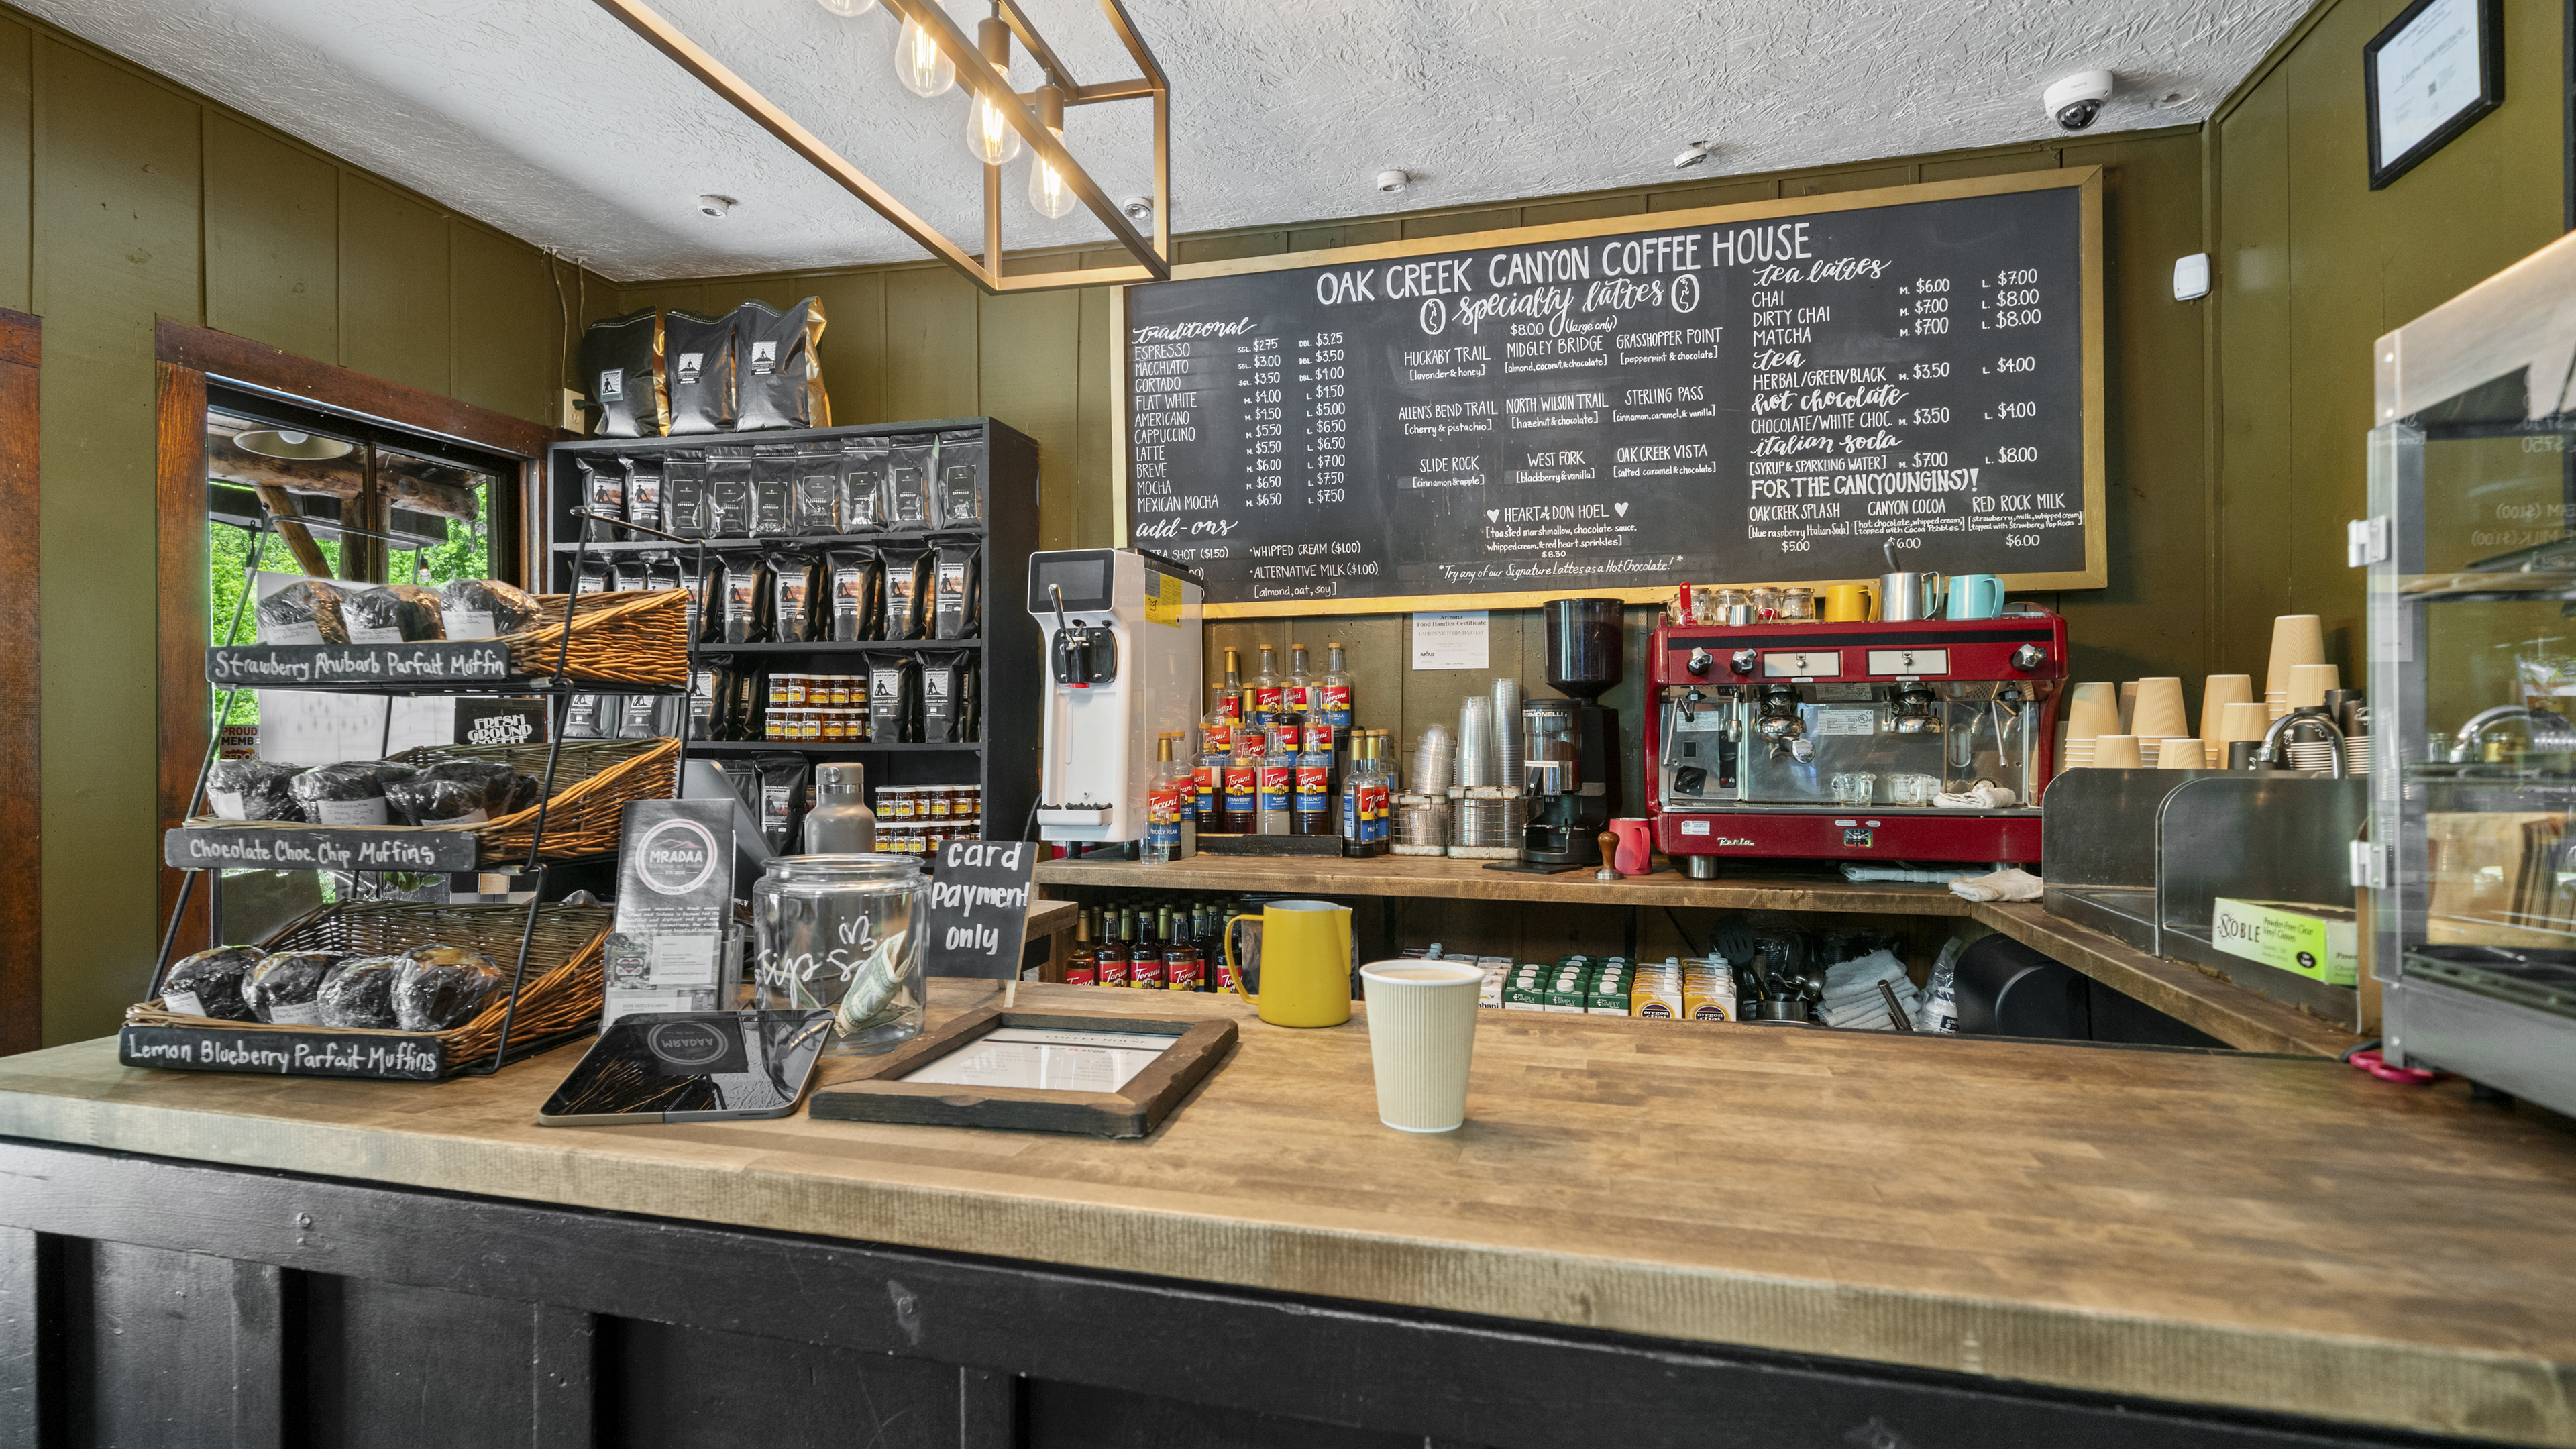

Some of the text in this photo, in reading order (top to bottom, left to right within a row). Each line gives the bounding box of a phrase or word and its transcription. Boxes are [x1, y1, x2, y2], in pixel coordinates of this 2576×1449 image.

[1317, 222, 1812, 305] OAK CREEK CANYON COFFEE HOUSE
[1753, 258, 1891, 286] tea lattes
[1752, 269, 2037, 307] CHAI $6.00 $7.00
[1452, 278, 1664, 337] specialty lattes
[1754, 306, 1829, 327] DIRTY CHAI
[1132, 317, 1257, 344] traditional
[1511, 315, 1617, 336] $8.00 (large only)
[1135, 332, 1343, 361] ESPRESSO $2.75 $3.25
[1507, 335, 1603, 358] MIDGLEY BRIDGE
[1617, 327, 1723, 349] GRASSHOPPER POINT
[1754, 327, 1811, 347] MATCHA
[1405, 346, 1491, 366] HUCKABY TRAIL
[1753, 349, 1806, 370] tea
[1136, 360, 1188, 376] MACCHIATO
[1410, 364, 1485, 380] [lavender & honey]
[1136, 377, 1181, 392] CORTADO
[1752, 366, 1886, 390] HERBAL/GREEN/BLACK
[1136, 392, 1197, 411] FLAT WHITE
[1507, 393, 1609, 413] NORTH WILSON TRAIL
[1625, 386, 1703, 405] STERLING PASS
[1752, 384, 1909, 415] hot chocolate
[1135, 411, 1189, 427] AMERICANO
[1399, 401, 1498, 420] ALLEN'S BEND TRAIL
[1752, 411, 1892, 434] CHOCOLATE/WHITE CHOC.
[1135, 427, 1195, 444] CAPPUCCINO
[1750, 430, 1902, 457] italian soda
[1136, 445, 1164, 461] LATTE
[1527, 451, 1585, 466] WEST FORK
[1617, 444, 1707, 462] OAK CREEK VISTA
[1137, 463, 1167, 478] BREVE
[1420, 456, 1479, 472] SLIDE ROCK
[1138, 480, 1171, 495] MOCHA
[1751, 468, 1979, 500] FOR THE CAN(YOUNGINS)!
[1138, 494, 1218, 512] MEXICAN MOCHA
[1750, 503, 1839, 521] OAK CREEK SPLASH
[1868, 498, 1945, 515] CANYON COCOA
[1972, 493, 2065, 513] RED ROCK MILK
[1505, 506, 1541, 522] HEART
[1553, 506, 1574, 519] DON
[1579, 504, 1609, 518] HOEL
[1136, 517, 1238, 538] add-ons
[1172, 546, 1228, 560] SHOT ($1.50)
[1253, 541, 1360, 557] WHIPPED CREAM ($1.00)
[1254, 561, 1378, 578] ALTERNATIVE MILK ($1.00)
[1460, 572, 1476, 584] any
[1477, 564, 1490, 584] of
[1506, 563, 1552, 580] Signature
[1553, 561, 1585, 574] Lattes
[1606, 560, 1623, 572] Hot
[215, 650, 505, 681] Strawberry Rhubarb Parfait Muffin
[1325, 690, 1347, 703] Torani
[222, 727, 258, 736] PROUD
[468, 724, 532, 740] GROUND
[474, 714, 525, 731] FRESH
[1227, 773, 1250, 788] Torani
[1267, 772, 1288, 788] Torani
[190, 838, 435, 868] Chocolate Choc. Chip Muffins
[649, 850, 703, 863] MRADAA
[947, 842, 1022, 871] card
[2220, 914, 2261, 943] NOBLE
[2297, 924, 2314, 936] Clear
[945, 924, 998, 955] only
[1135, 966, 1161, 982] Torani
[129, 1033, 437, 1073] Lemon Blueberry Parfait Muffins
